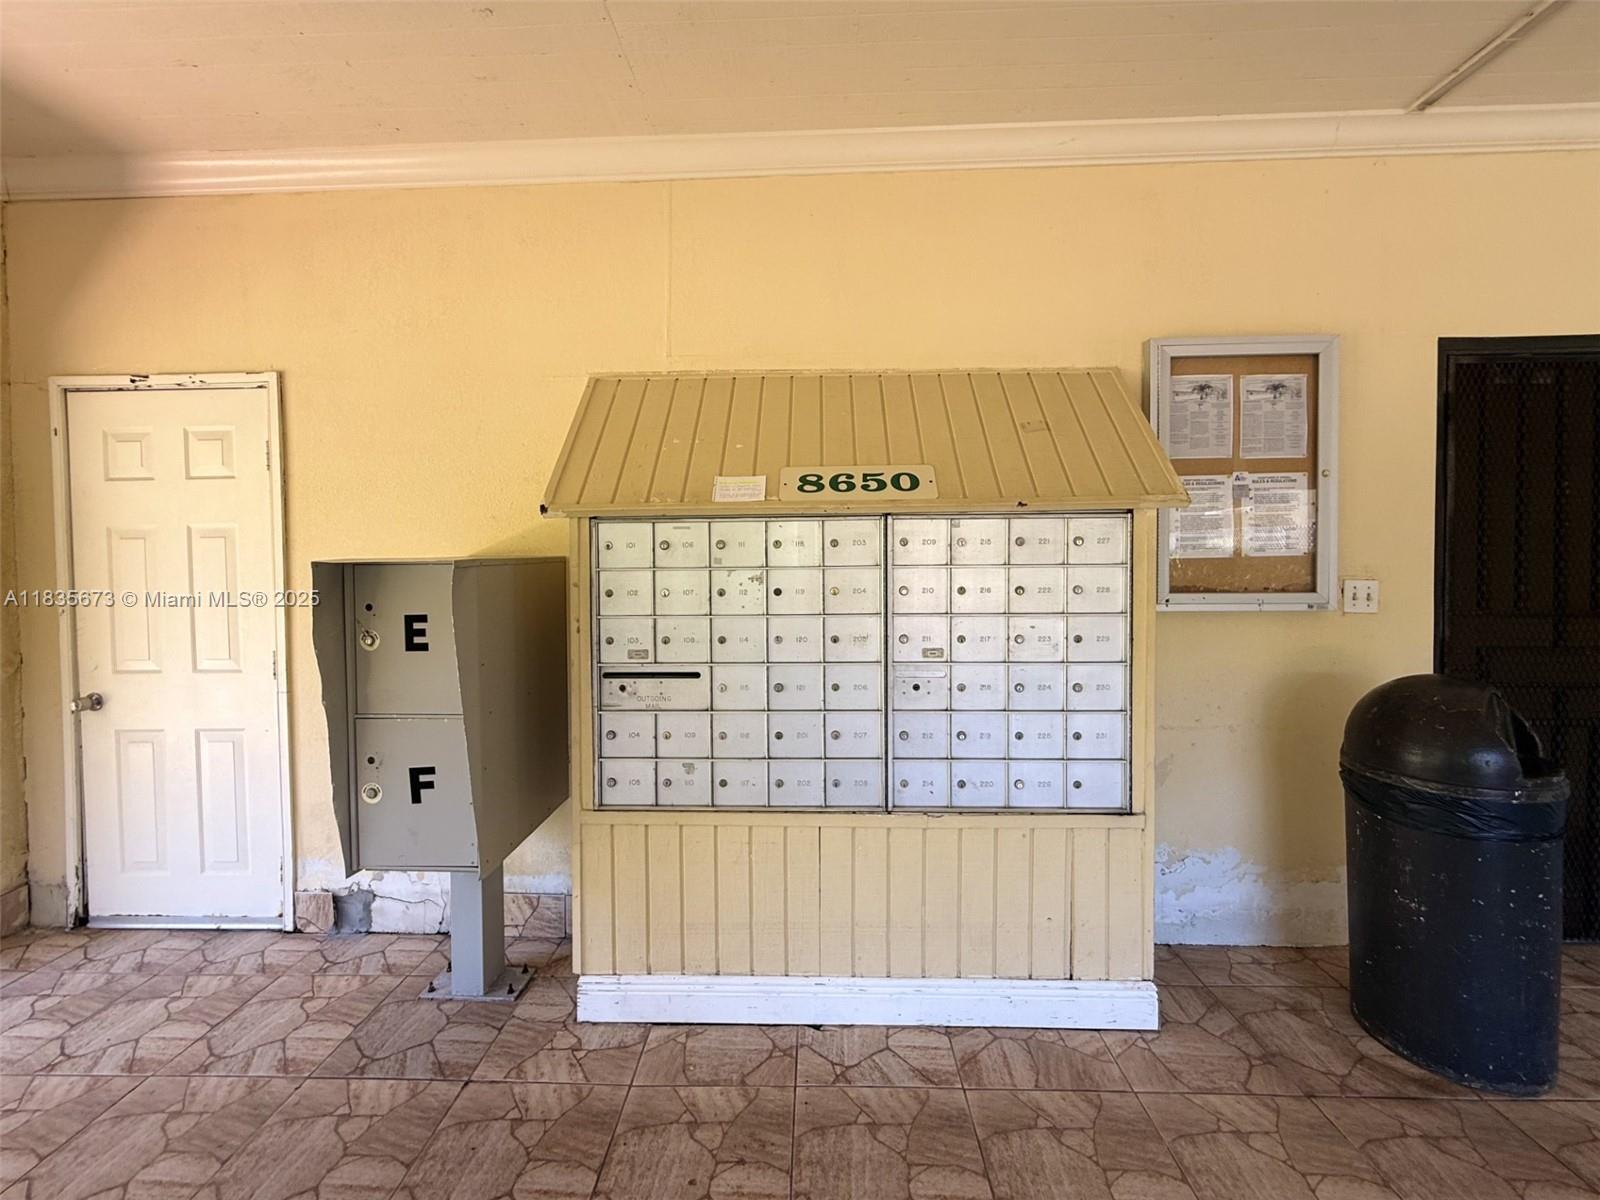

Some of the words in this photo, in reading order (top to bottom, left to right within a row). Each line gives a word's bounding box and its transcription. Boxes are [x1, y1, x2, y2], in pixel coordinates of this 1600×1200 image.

[797, 472, 920, 493] 8650
[404, 614, 429, 652] E
[409, 766, 436, 804] F
